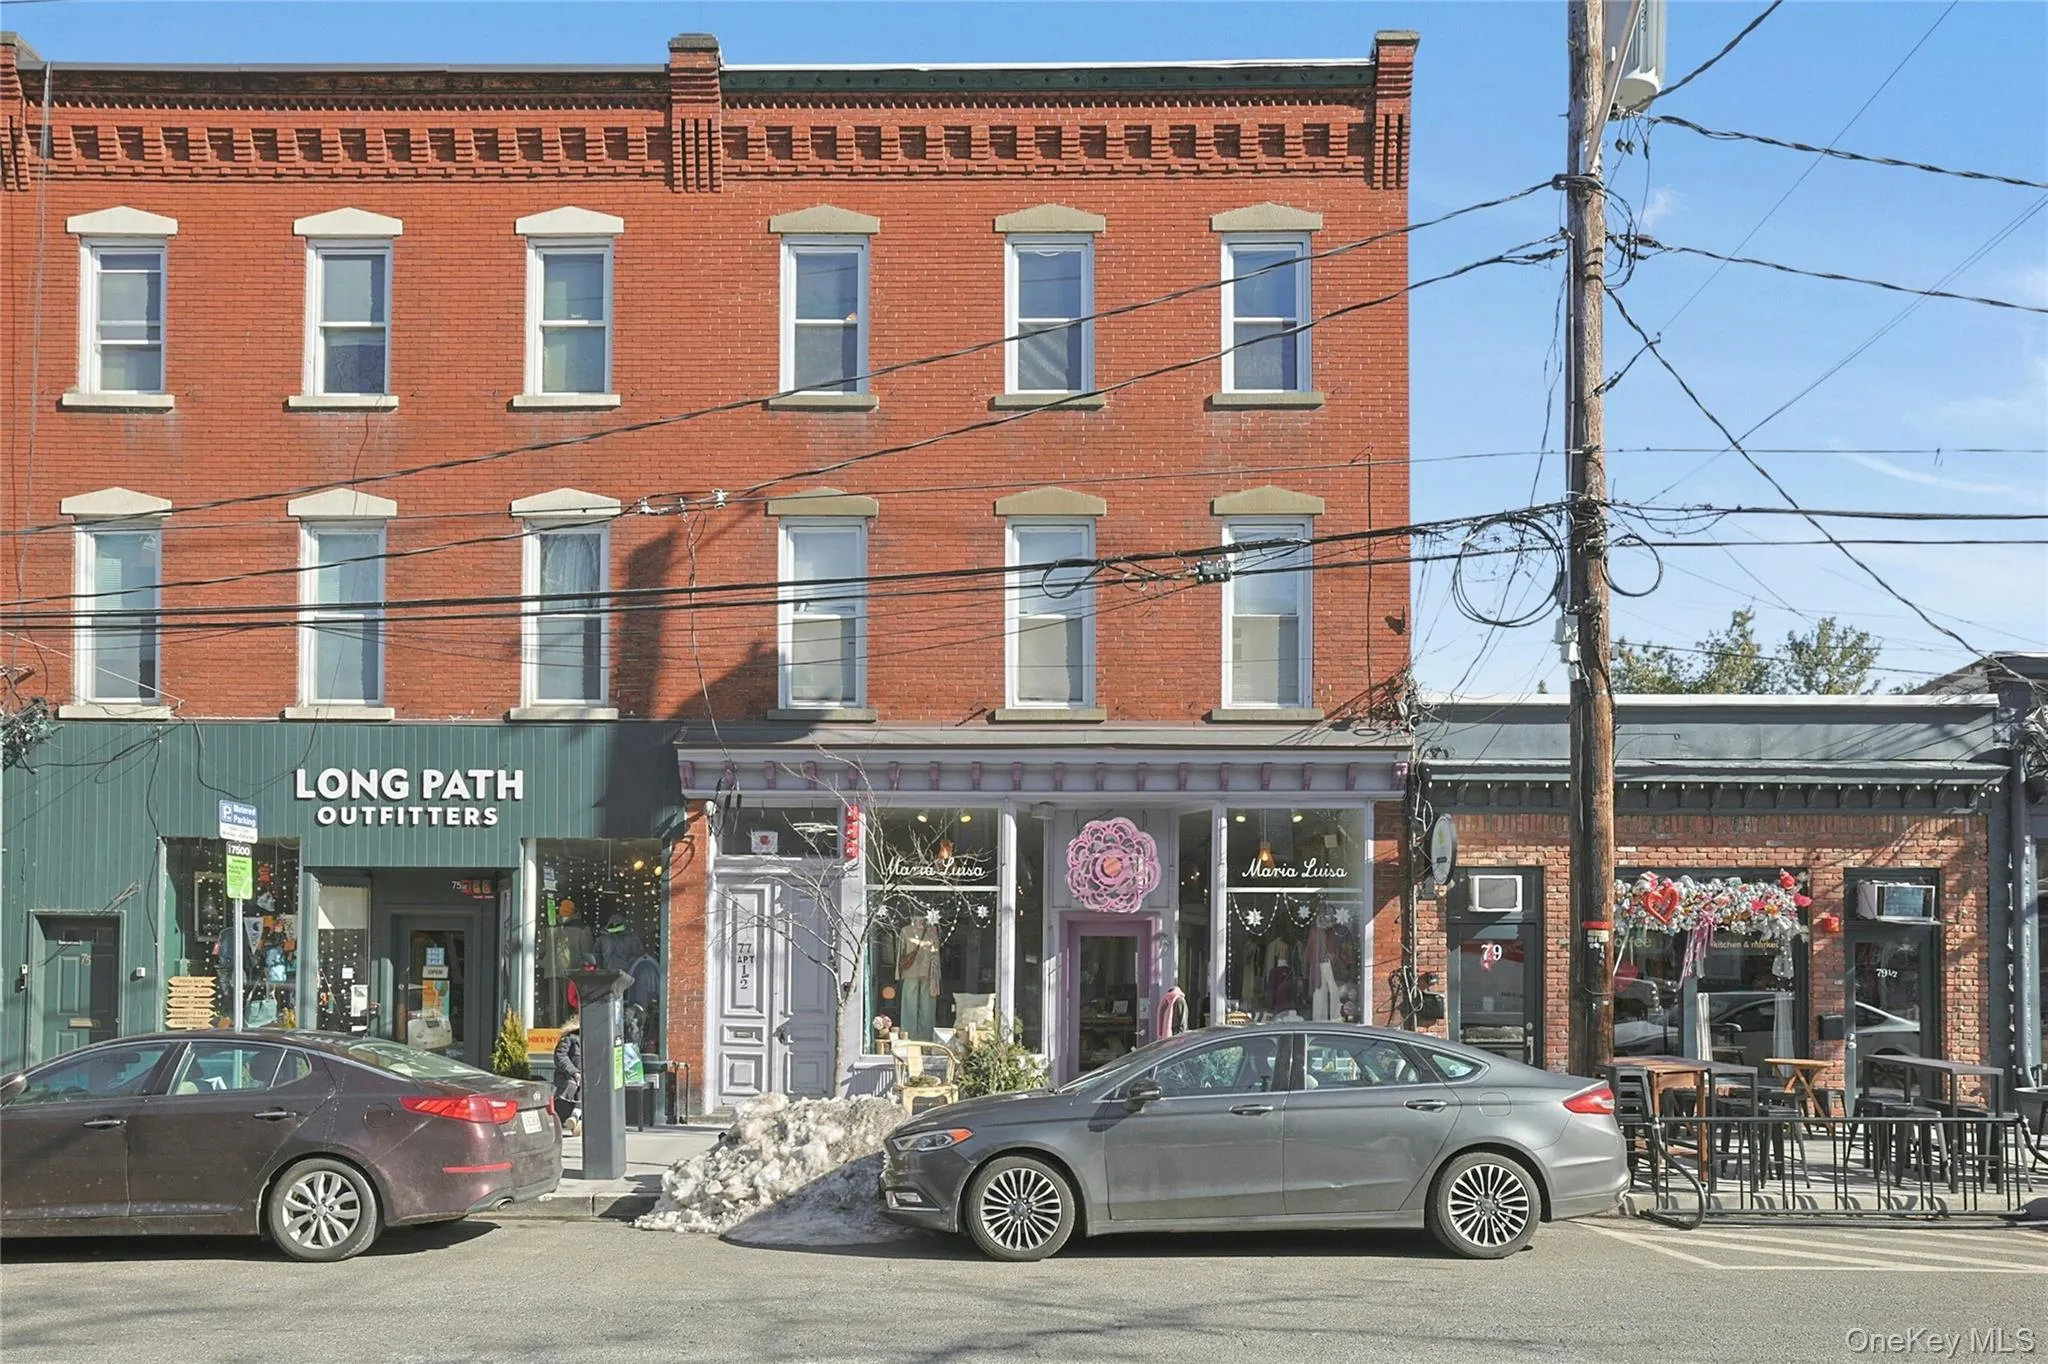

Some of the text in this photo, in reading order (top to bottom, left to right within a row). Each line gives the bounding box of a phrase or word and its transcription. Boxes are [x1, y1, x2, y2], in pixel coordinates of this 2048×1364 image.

[296, 768, 524, 800] LONG PATH
[233, 803, 257, 816] Metered
[317, 806, 498, 825] OUTFITTERS
[233, 814, 256, 828] Parking
[881, 856, 986, 877] Maria Luisa
[1241, 857, 1348, 878] Maria Luisa
[737, 943, 752, 953] 77
[1480, 944, 1503, 961] 79
[737, 955, 755, 964] APT
[740, 979, 748, 989] 2
